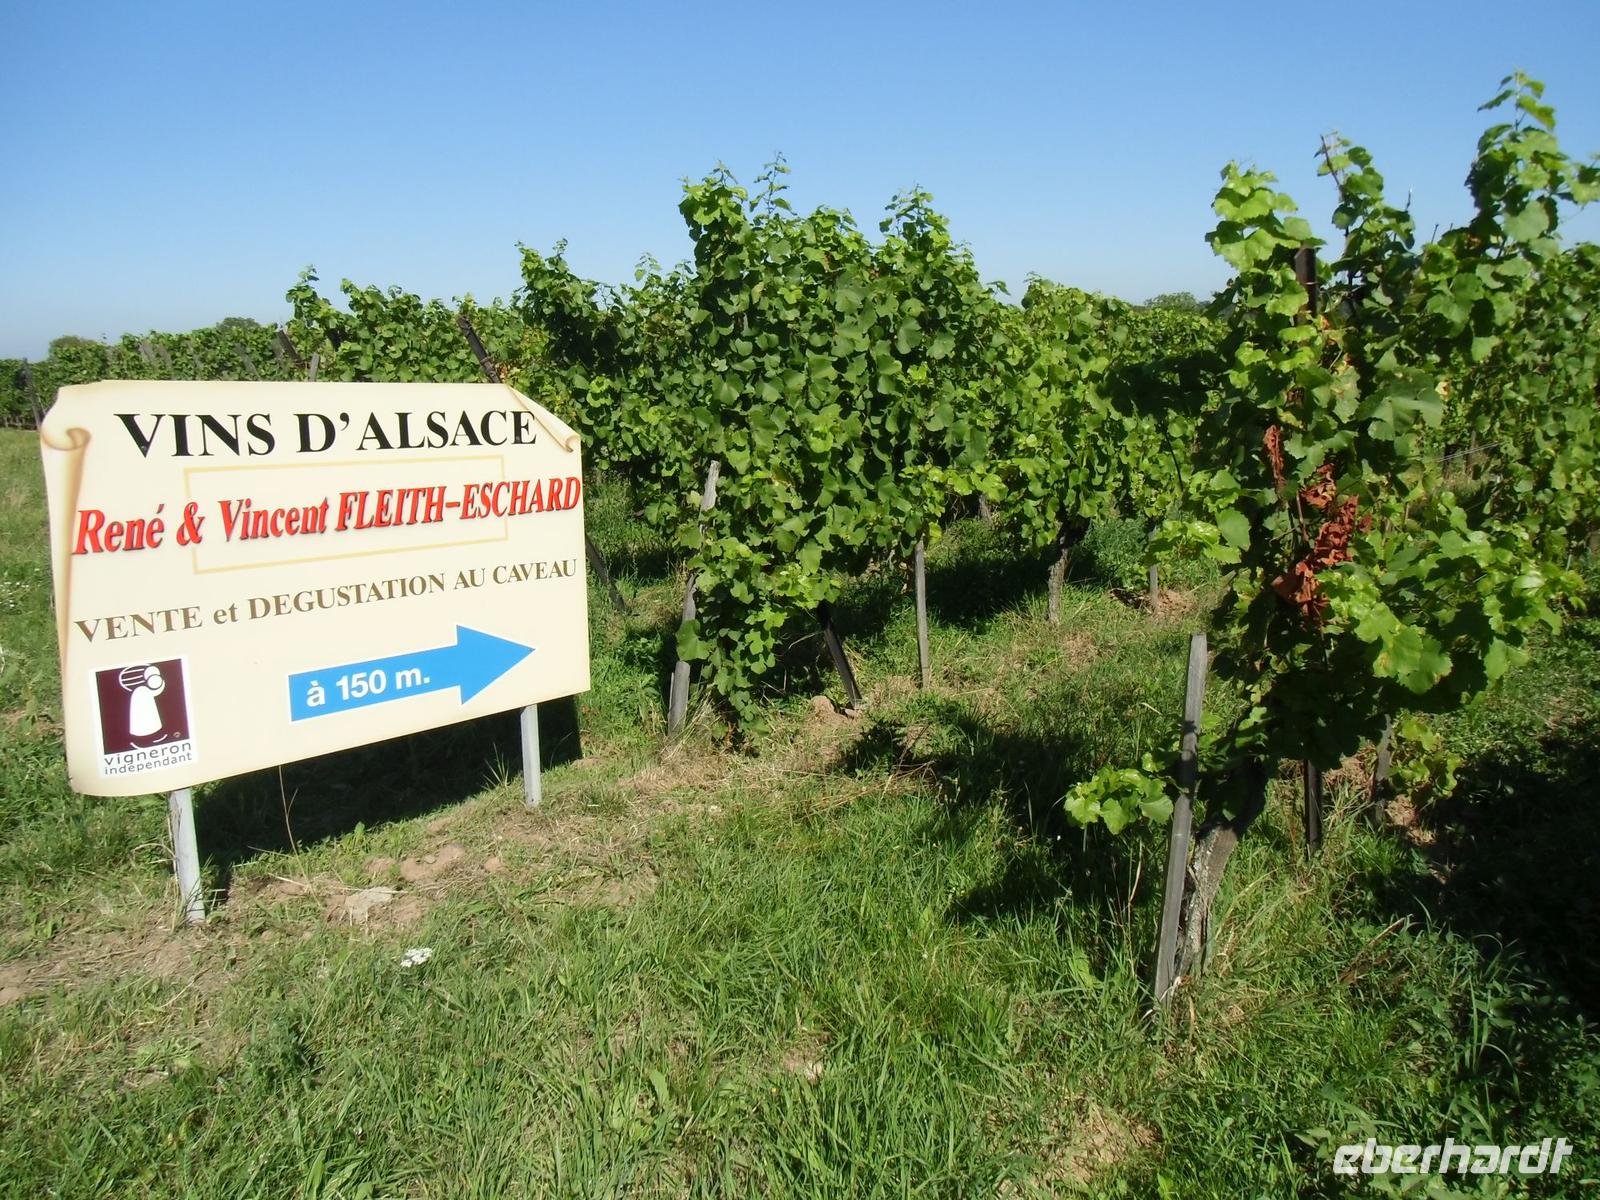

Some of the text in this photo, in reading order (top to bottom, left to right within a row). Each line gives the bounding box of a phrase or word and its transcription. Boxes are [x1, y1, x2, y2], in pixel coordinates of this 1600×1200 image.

[114, 412, 275, 458] VINS
[72, 475, 582, 556] René & Vincent FLEITH-ESCHARD
[74, 558, 578, 644] VENTE et DEGUSTATION AU CAVEAU
[306, 668, 431, 707] à 150 m.
[104, 742, 192, 766] vigneron
